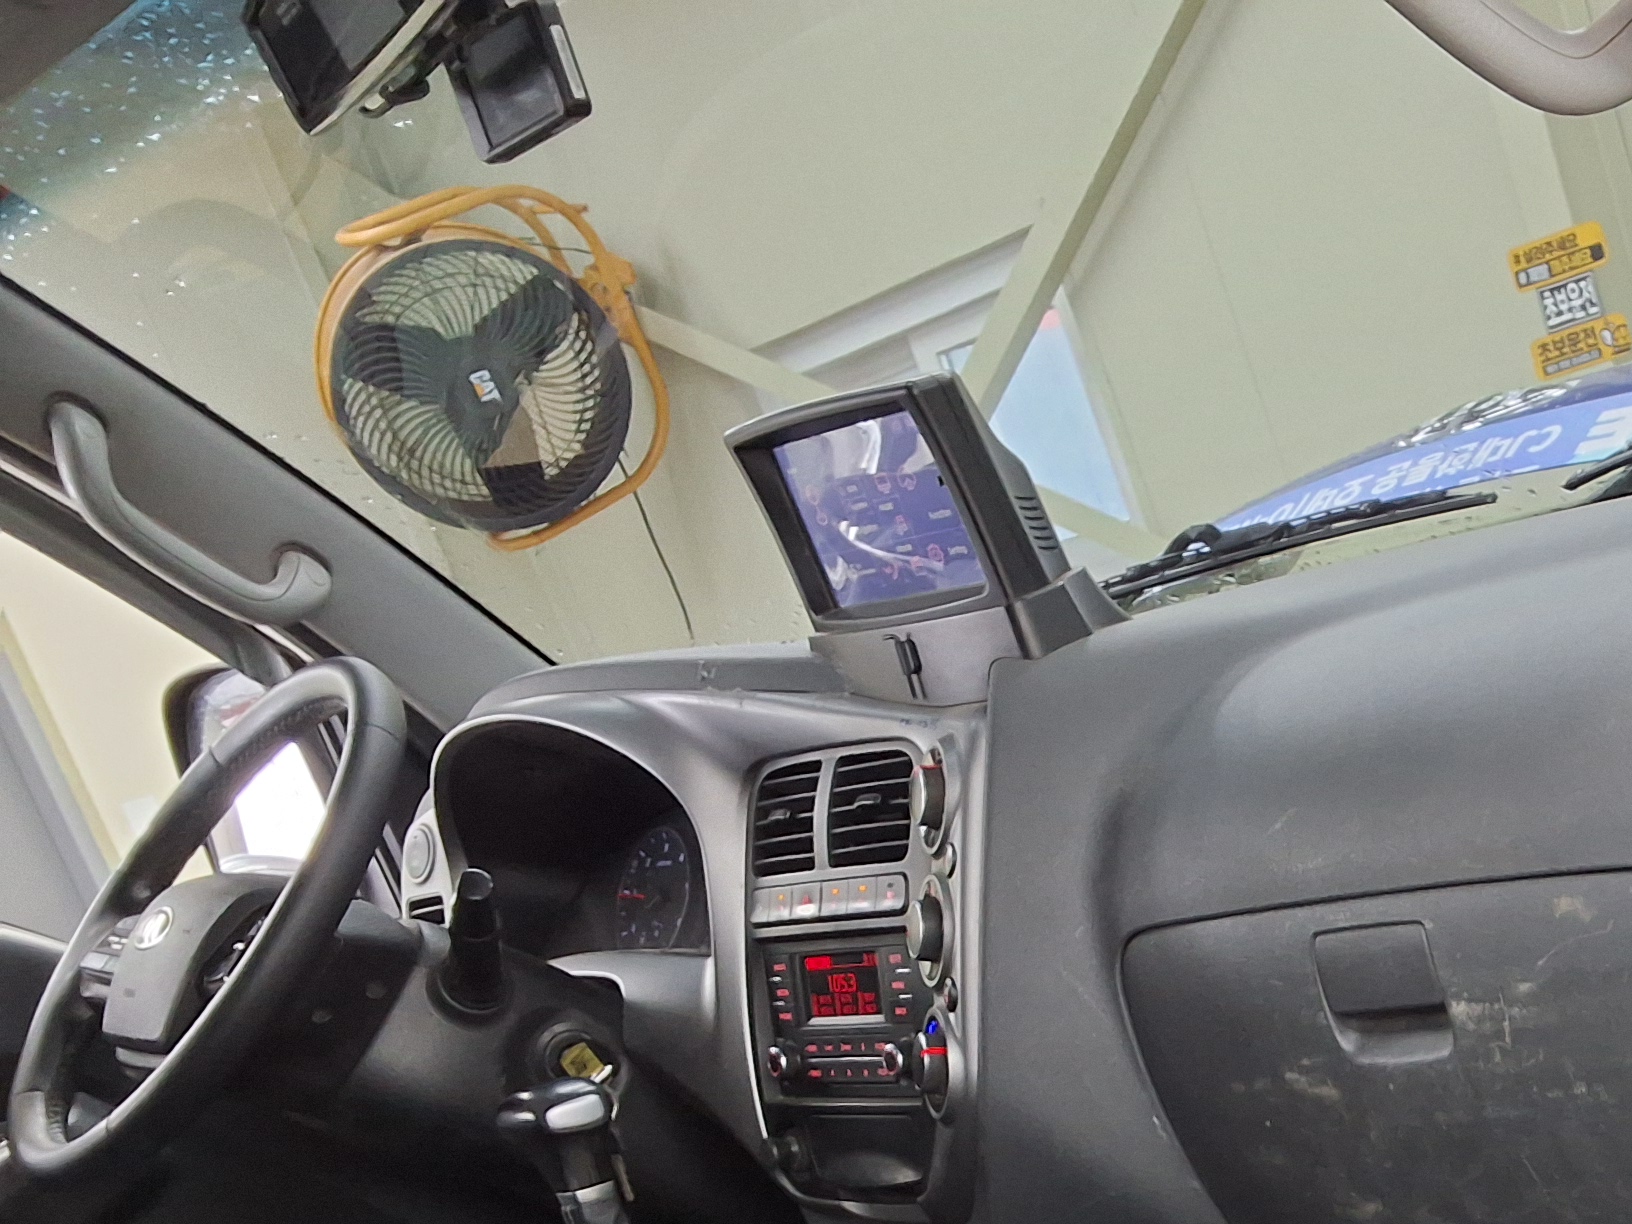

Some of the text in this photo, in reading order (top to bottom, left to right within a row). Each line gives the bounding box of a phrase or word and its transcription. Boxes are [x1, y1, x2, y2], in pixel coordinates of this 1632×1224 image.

[1541, 277, 1600, 327] 초보운전
[1537, 326, 1599, 364] 초보운전
[468, 369, 503, 403] CAT
[1371, 424, 1562, 496] CJ대한통운
